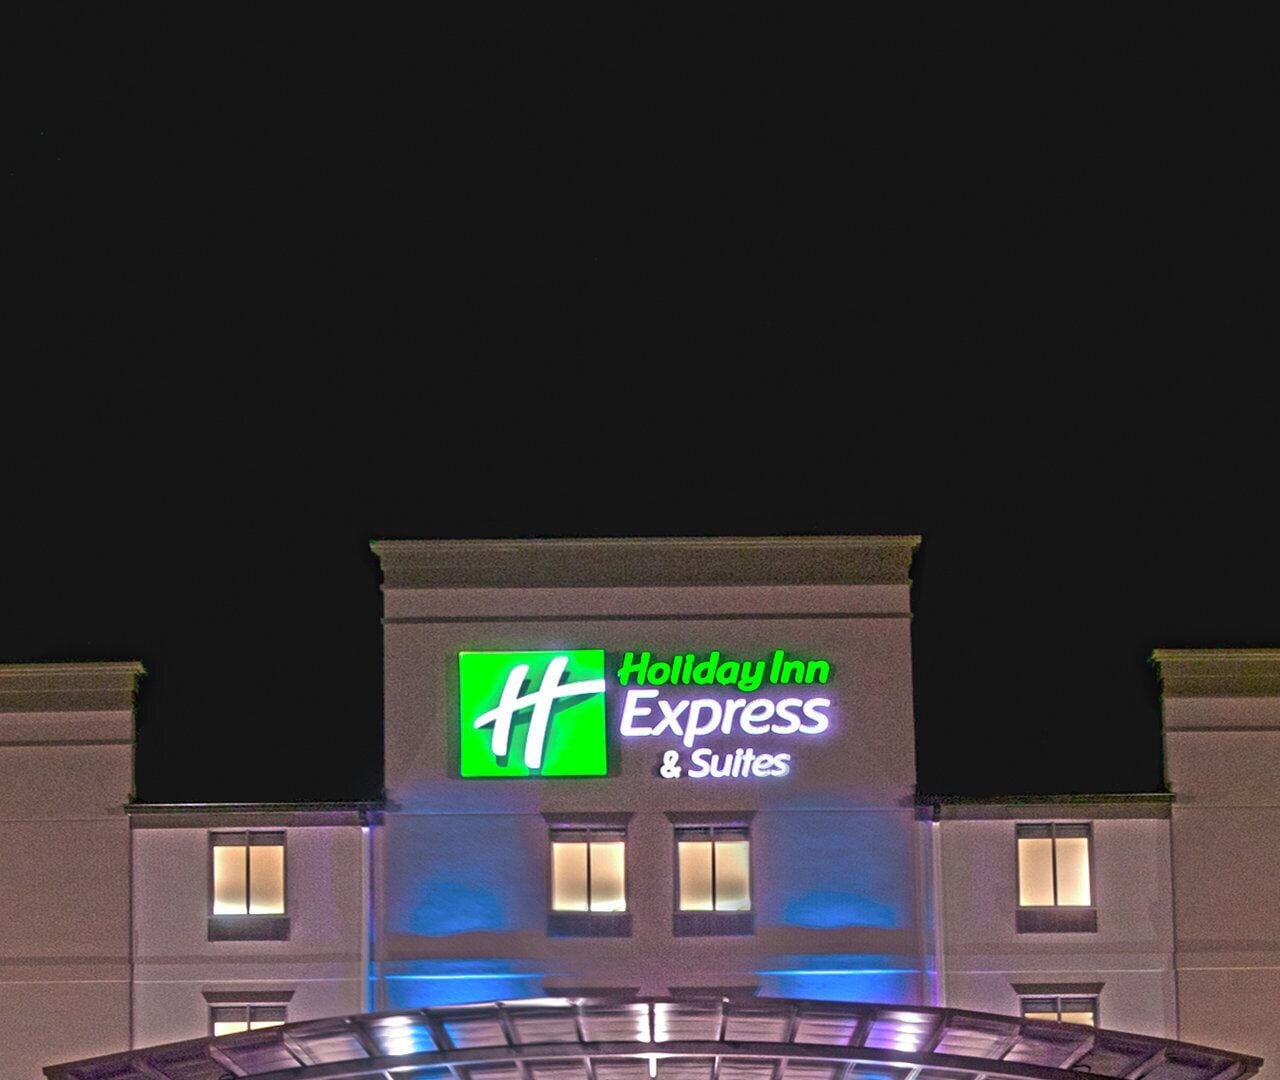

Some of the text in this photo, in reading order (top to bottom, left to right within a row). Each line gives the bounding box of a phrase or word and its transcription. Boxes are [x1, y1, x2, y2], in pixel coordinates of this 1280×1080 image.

[619, 650, 830, 691] Holiday Inn
[619, 689, 831, 747] Express
[660, 748, 790, 778] & Suites
